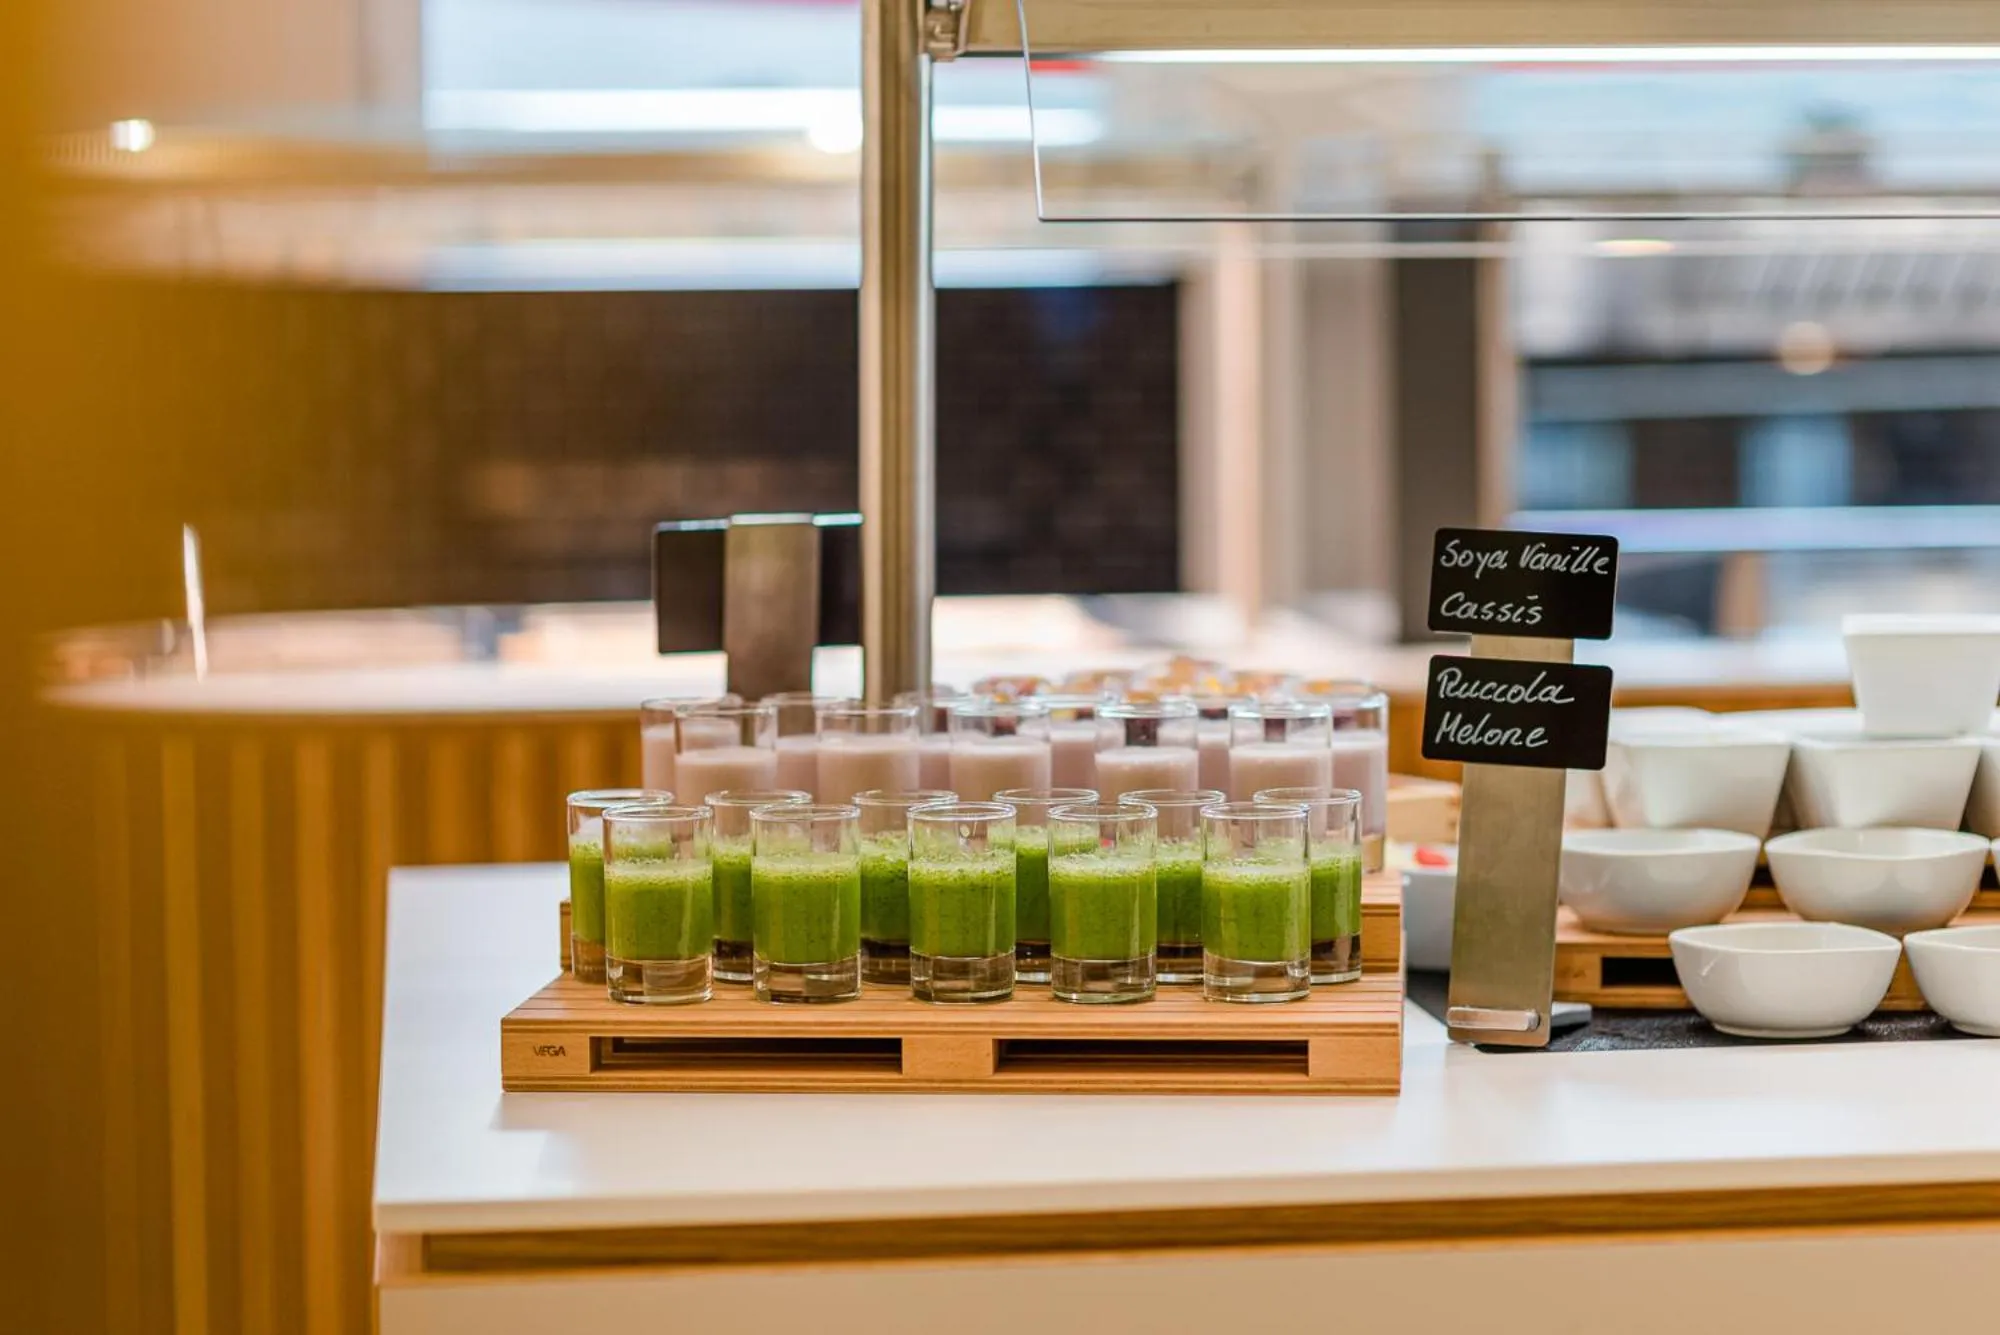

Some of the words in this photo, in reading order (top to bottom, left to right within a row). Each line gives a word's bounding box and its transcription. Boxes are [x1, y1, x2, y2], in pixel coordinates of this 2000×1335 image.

[1439, 538, 1509, 579] Soya
[1519, 543, 1609, 575] Vanille
[1440, 591, 1544, 625] Cassis
[1437, 666, 1575, 704] Ruccola
[1435, 711, 1549, 748] Melone
[532, 1044, 567, 1058] VEGA
